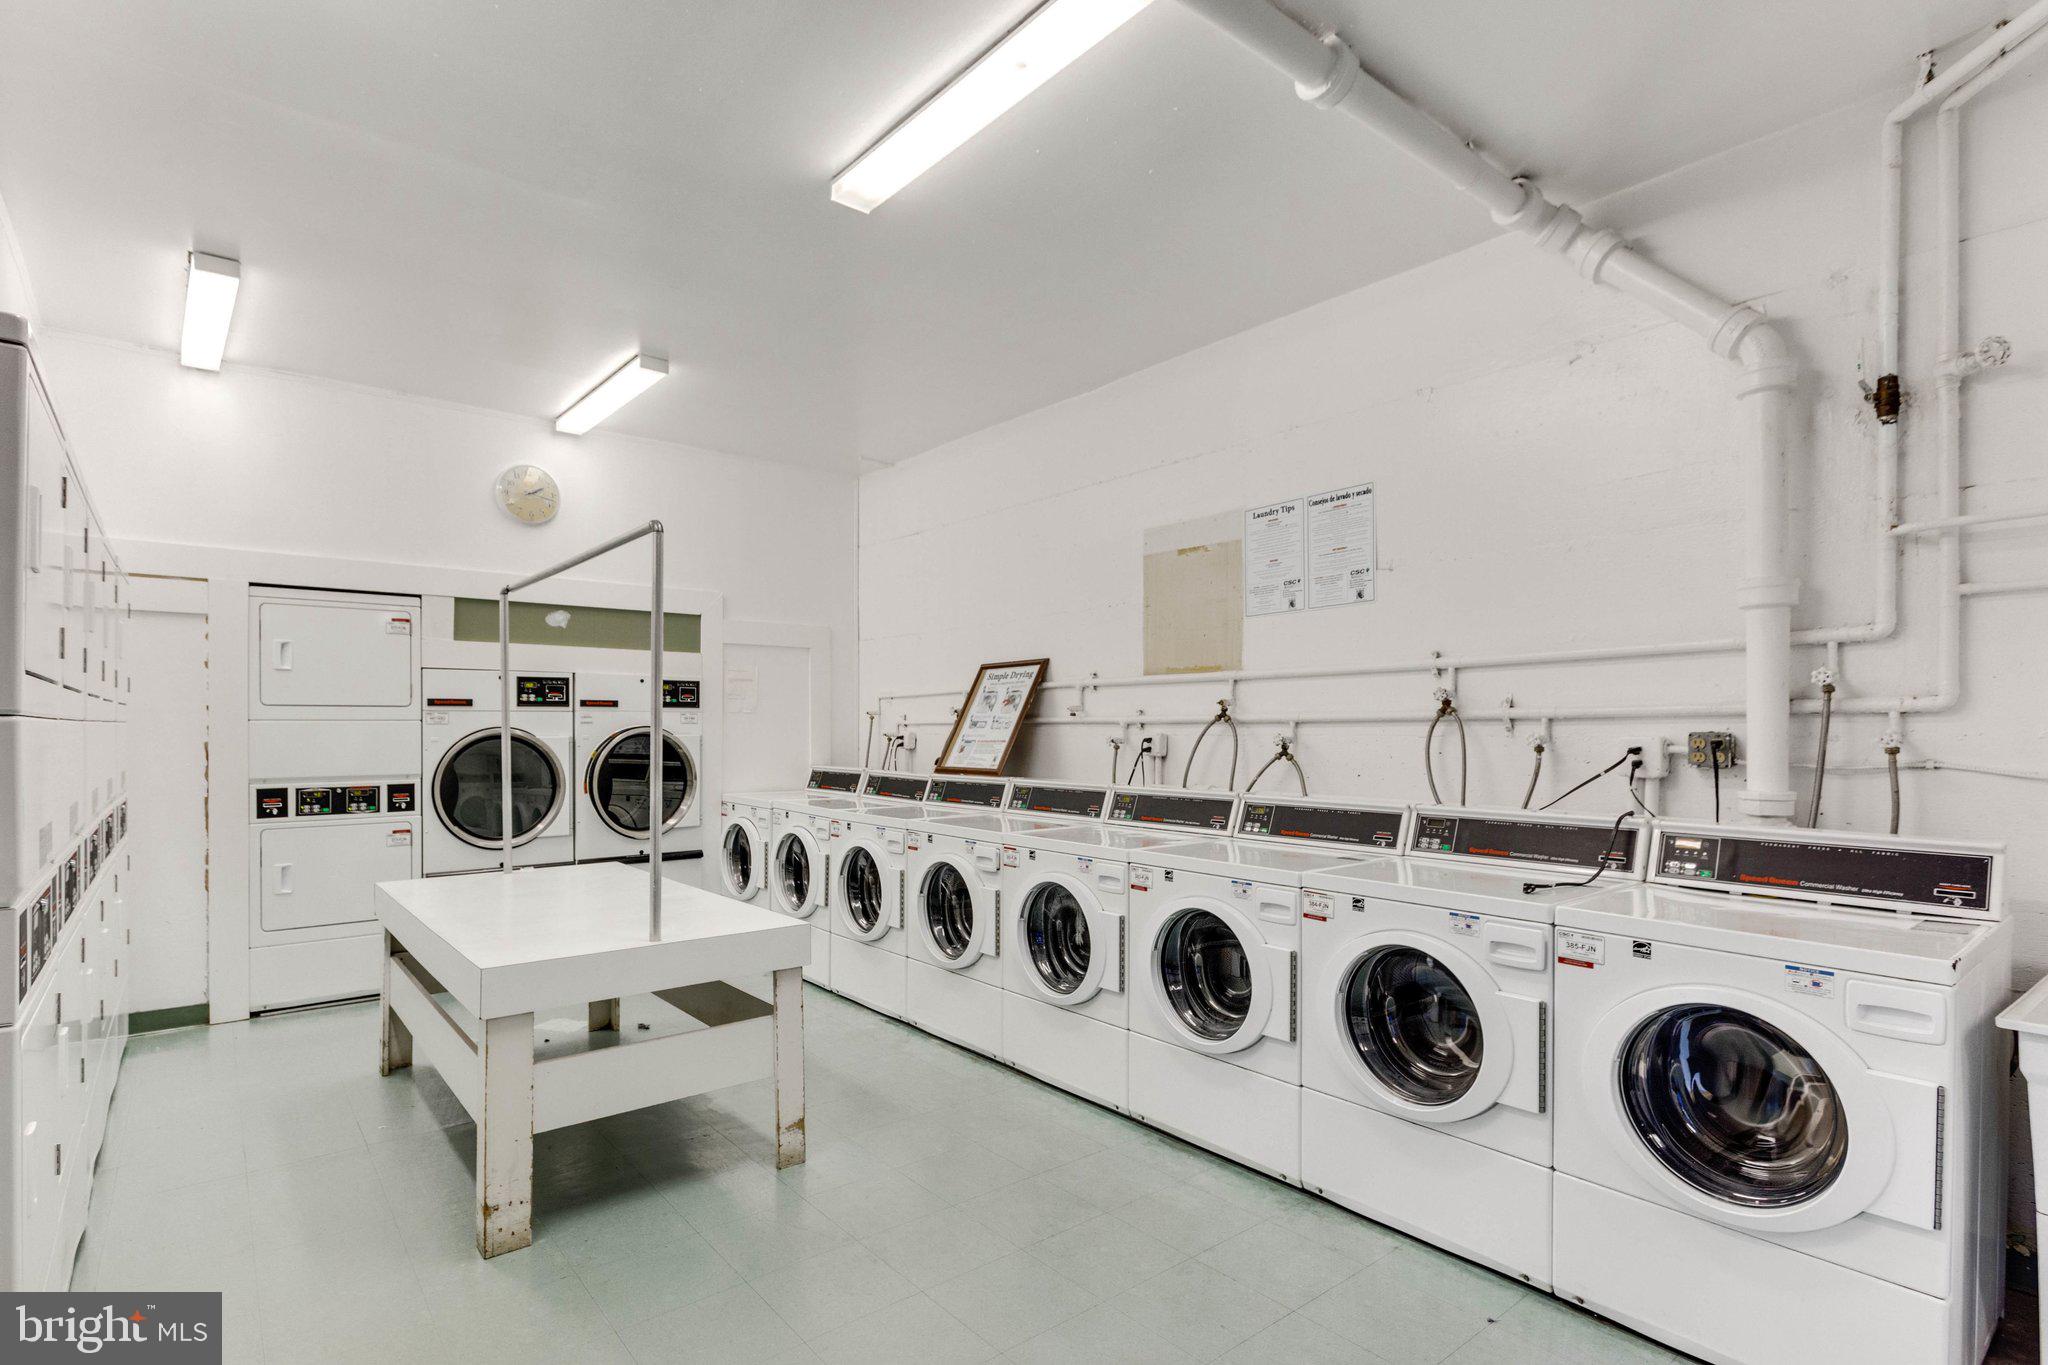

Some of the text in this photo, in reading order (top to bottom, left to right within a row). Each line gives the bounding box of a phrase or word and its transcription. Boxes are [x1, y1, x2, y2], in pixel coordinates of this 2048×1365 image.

[1308, 497, 1329, 507] Consejos
[1329, 495, 1335, 503] de
[1335, 491, 1352, 501] lavado
[1356, 487, 1373, 497] secado
[1253, 504, 1295, 519] Laundry Tips
[1349, 568, 1365, 576] CSC
[988, 671, 1034, 681] Simple Drying
[1800, 880, 1835, 890] Commercial
[1835, 884, 1859, 892] Washer
